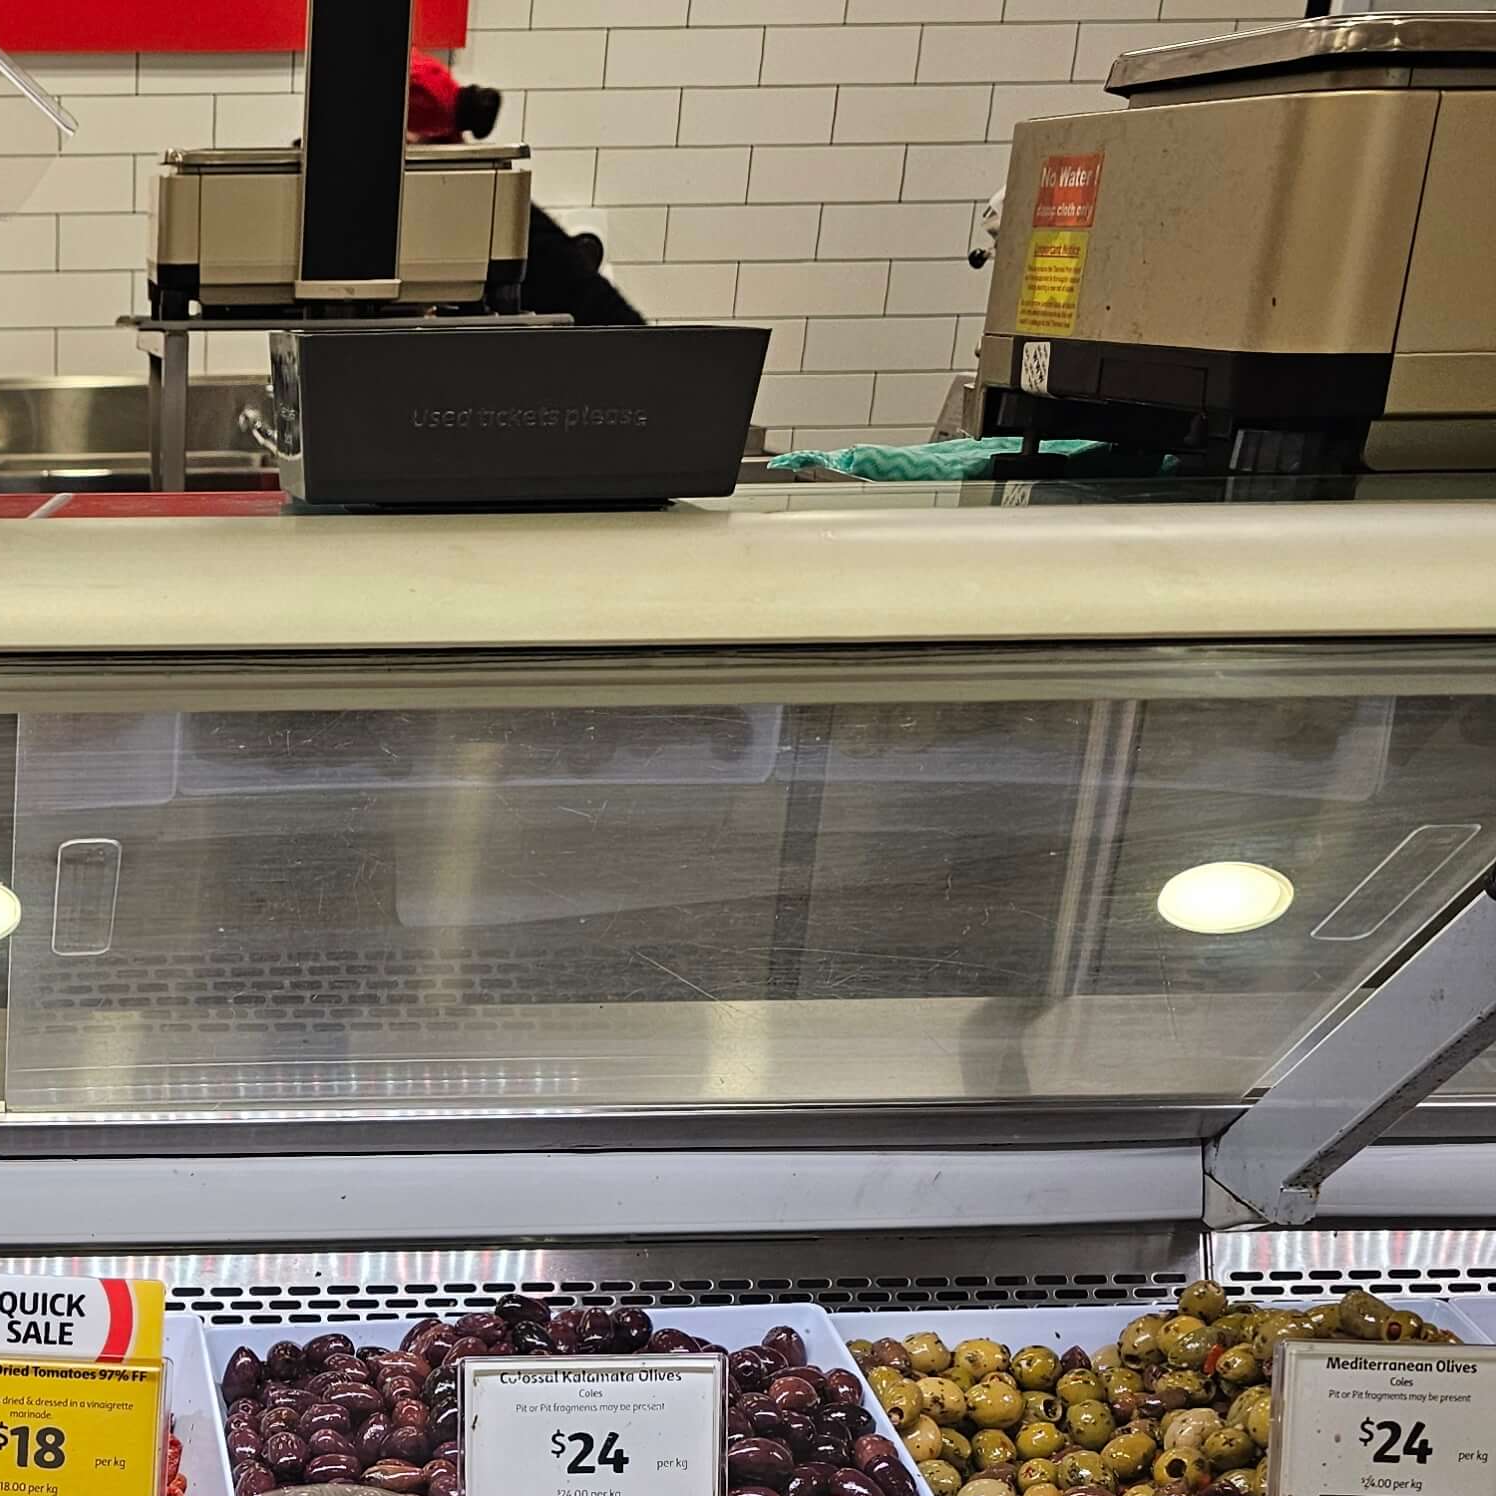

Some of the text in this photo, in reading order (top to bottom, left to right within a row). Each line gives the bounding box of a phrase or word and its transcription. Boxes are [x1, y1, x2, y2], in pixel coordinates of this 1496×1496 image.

[1041, 167, 1056, 186] No
[1059, 166, 1092, 186] Water
[410, 405, 648, 432] used tickets please
[6, 1320, 74, 1346] SALE
[1326, 1357, 1478, 1373] Mediterranean Olives
[32, 1366, 96, 1380] Tomatoes
[99, 1368, 129, 1382] 97%
[132, 1370, 148, 1382] FF
[563, 1371, 634, 1383] Kalamata
[639, 1369, 682, 1383] Olives
[1390, 1377, 1414, 1387] Coles
[579, 1388, 603, 1398] Coles
[1359, 1417, 1433, 1464] $24
[551, 1429, 630, 1474] $24
[1458, 1451, 1489, 1463] per kg
[95, 1457, 126, 1470] per kg
[656, 1458, 688, 1470] per kg
